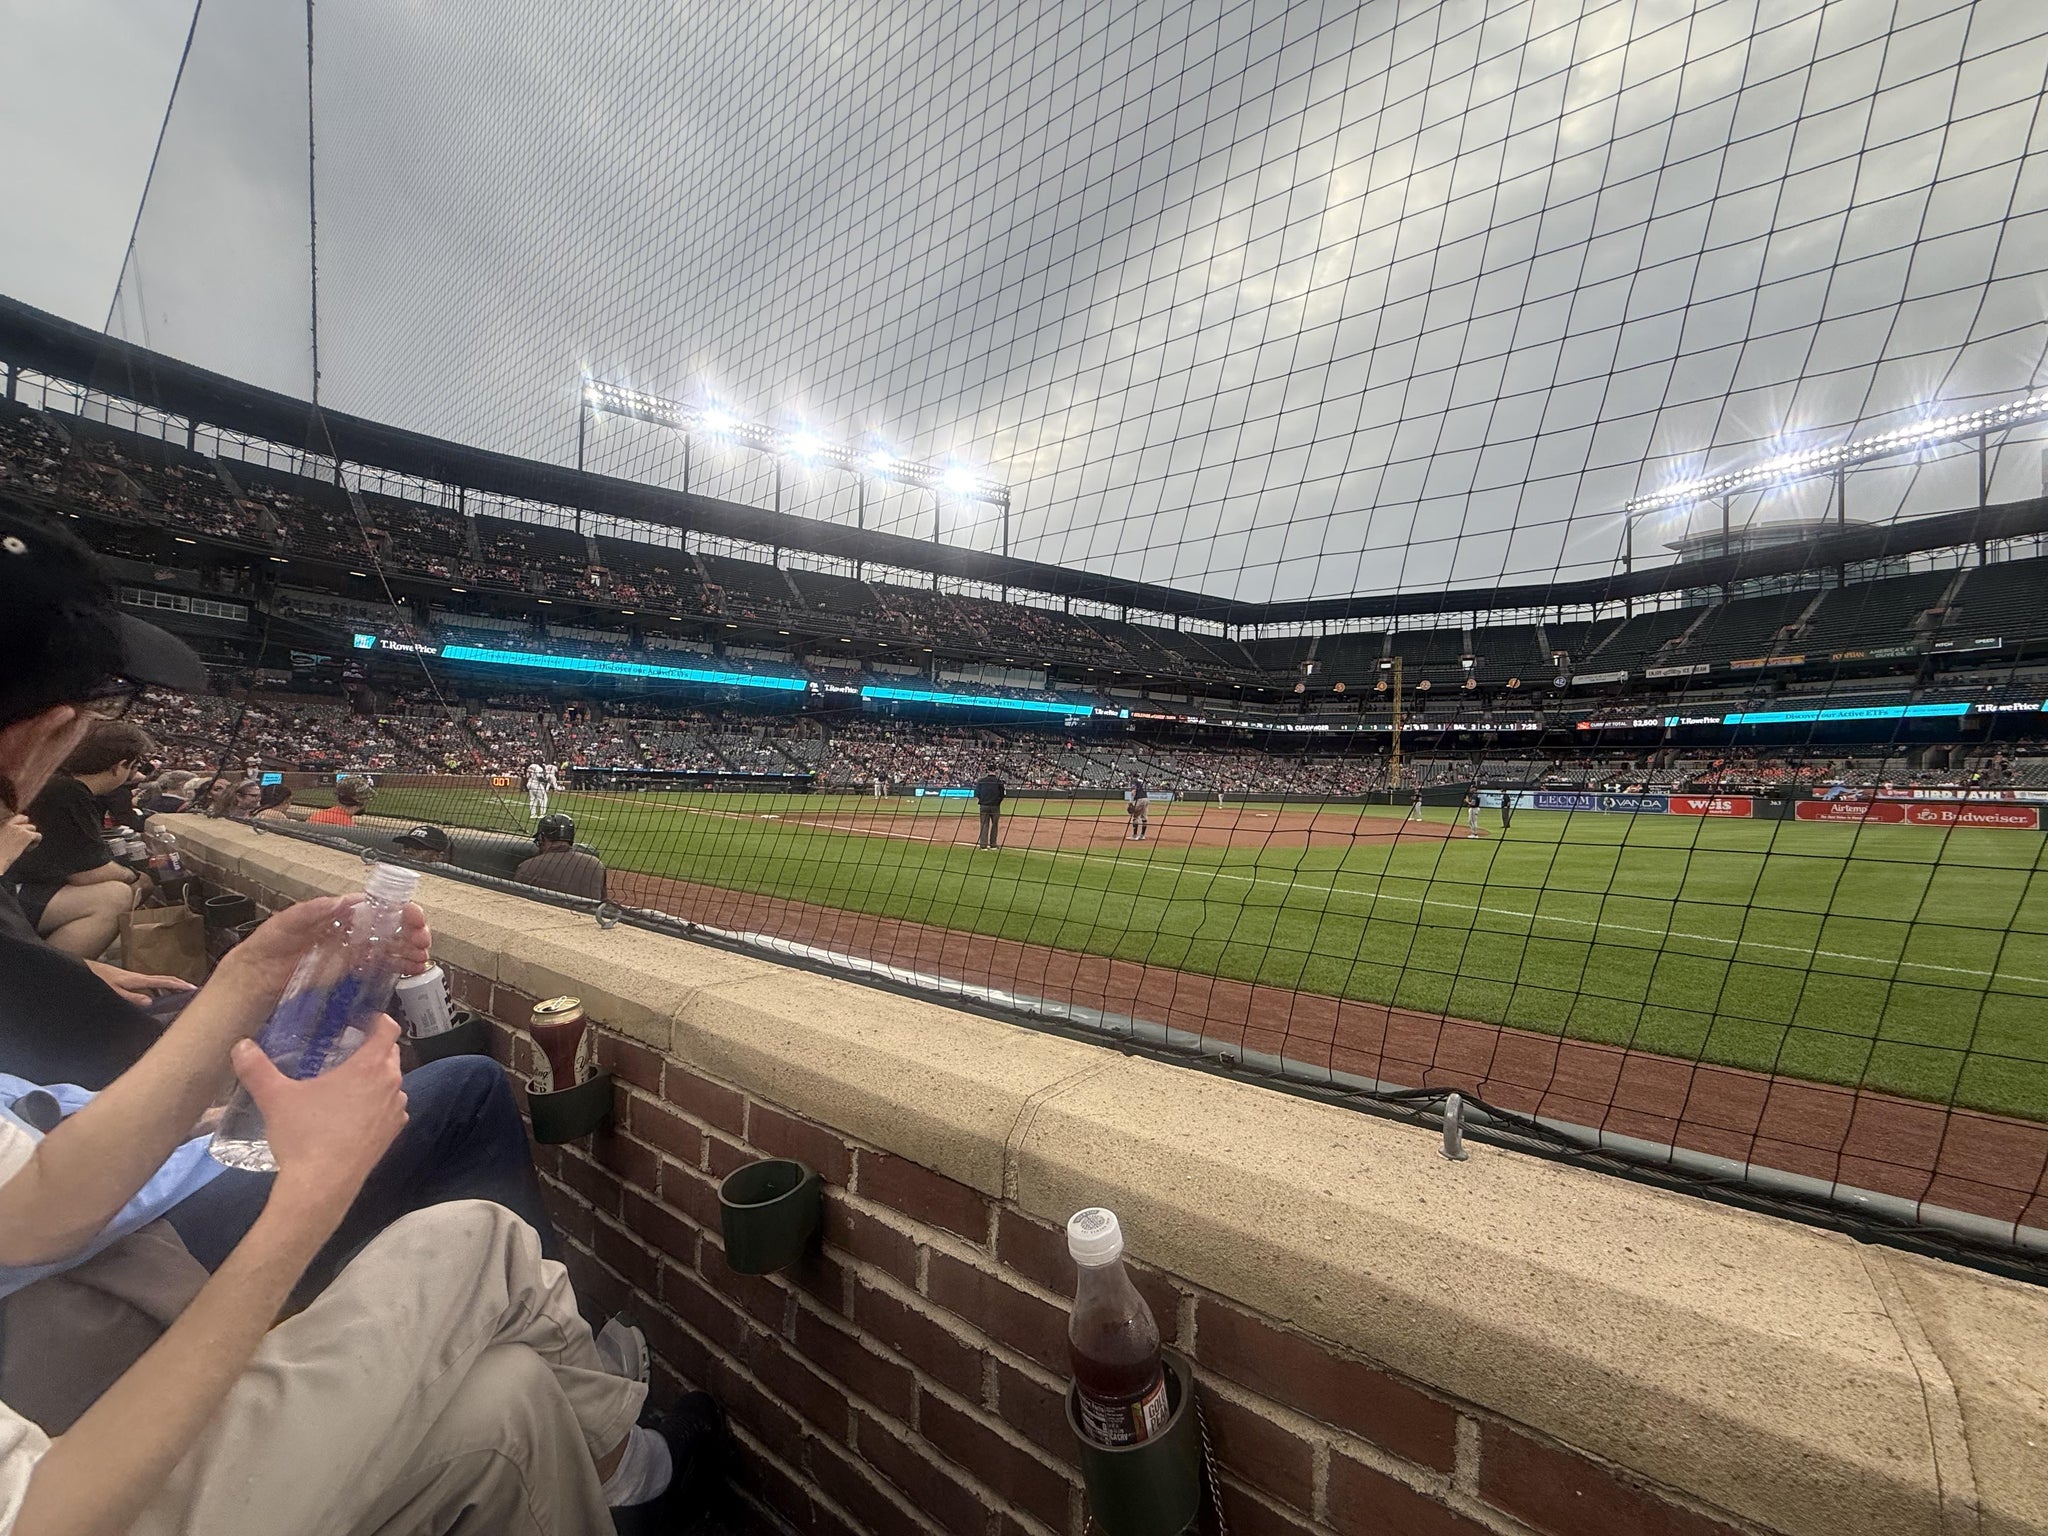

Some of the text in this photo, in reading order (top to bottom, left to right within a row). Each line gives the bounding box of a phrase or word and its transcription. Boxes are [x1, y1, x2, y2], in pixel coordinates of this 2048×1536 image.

[1295, 724, 1329, 732] CLEAVNGER
[493, 777, 510, 786] 007
[1914, 790, 1953, 799] BIRD
[1539, 796, 1590, 805] LECOM
[1687, 798, 1732, 810] weis
[1831, 803, 1868, 814] Airtemp
[1941, 811, 2028, 824] Budweiser
